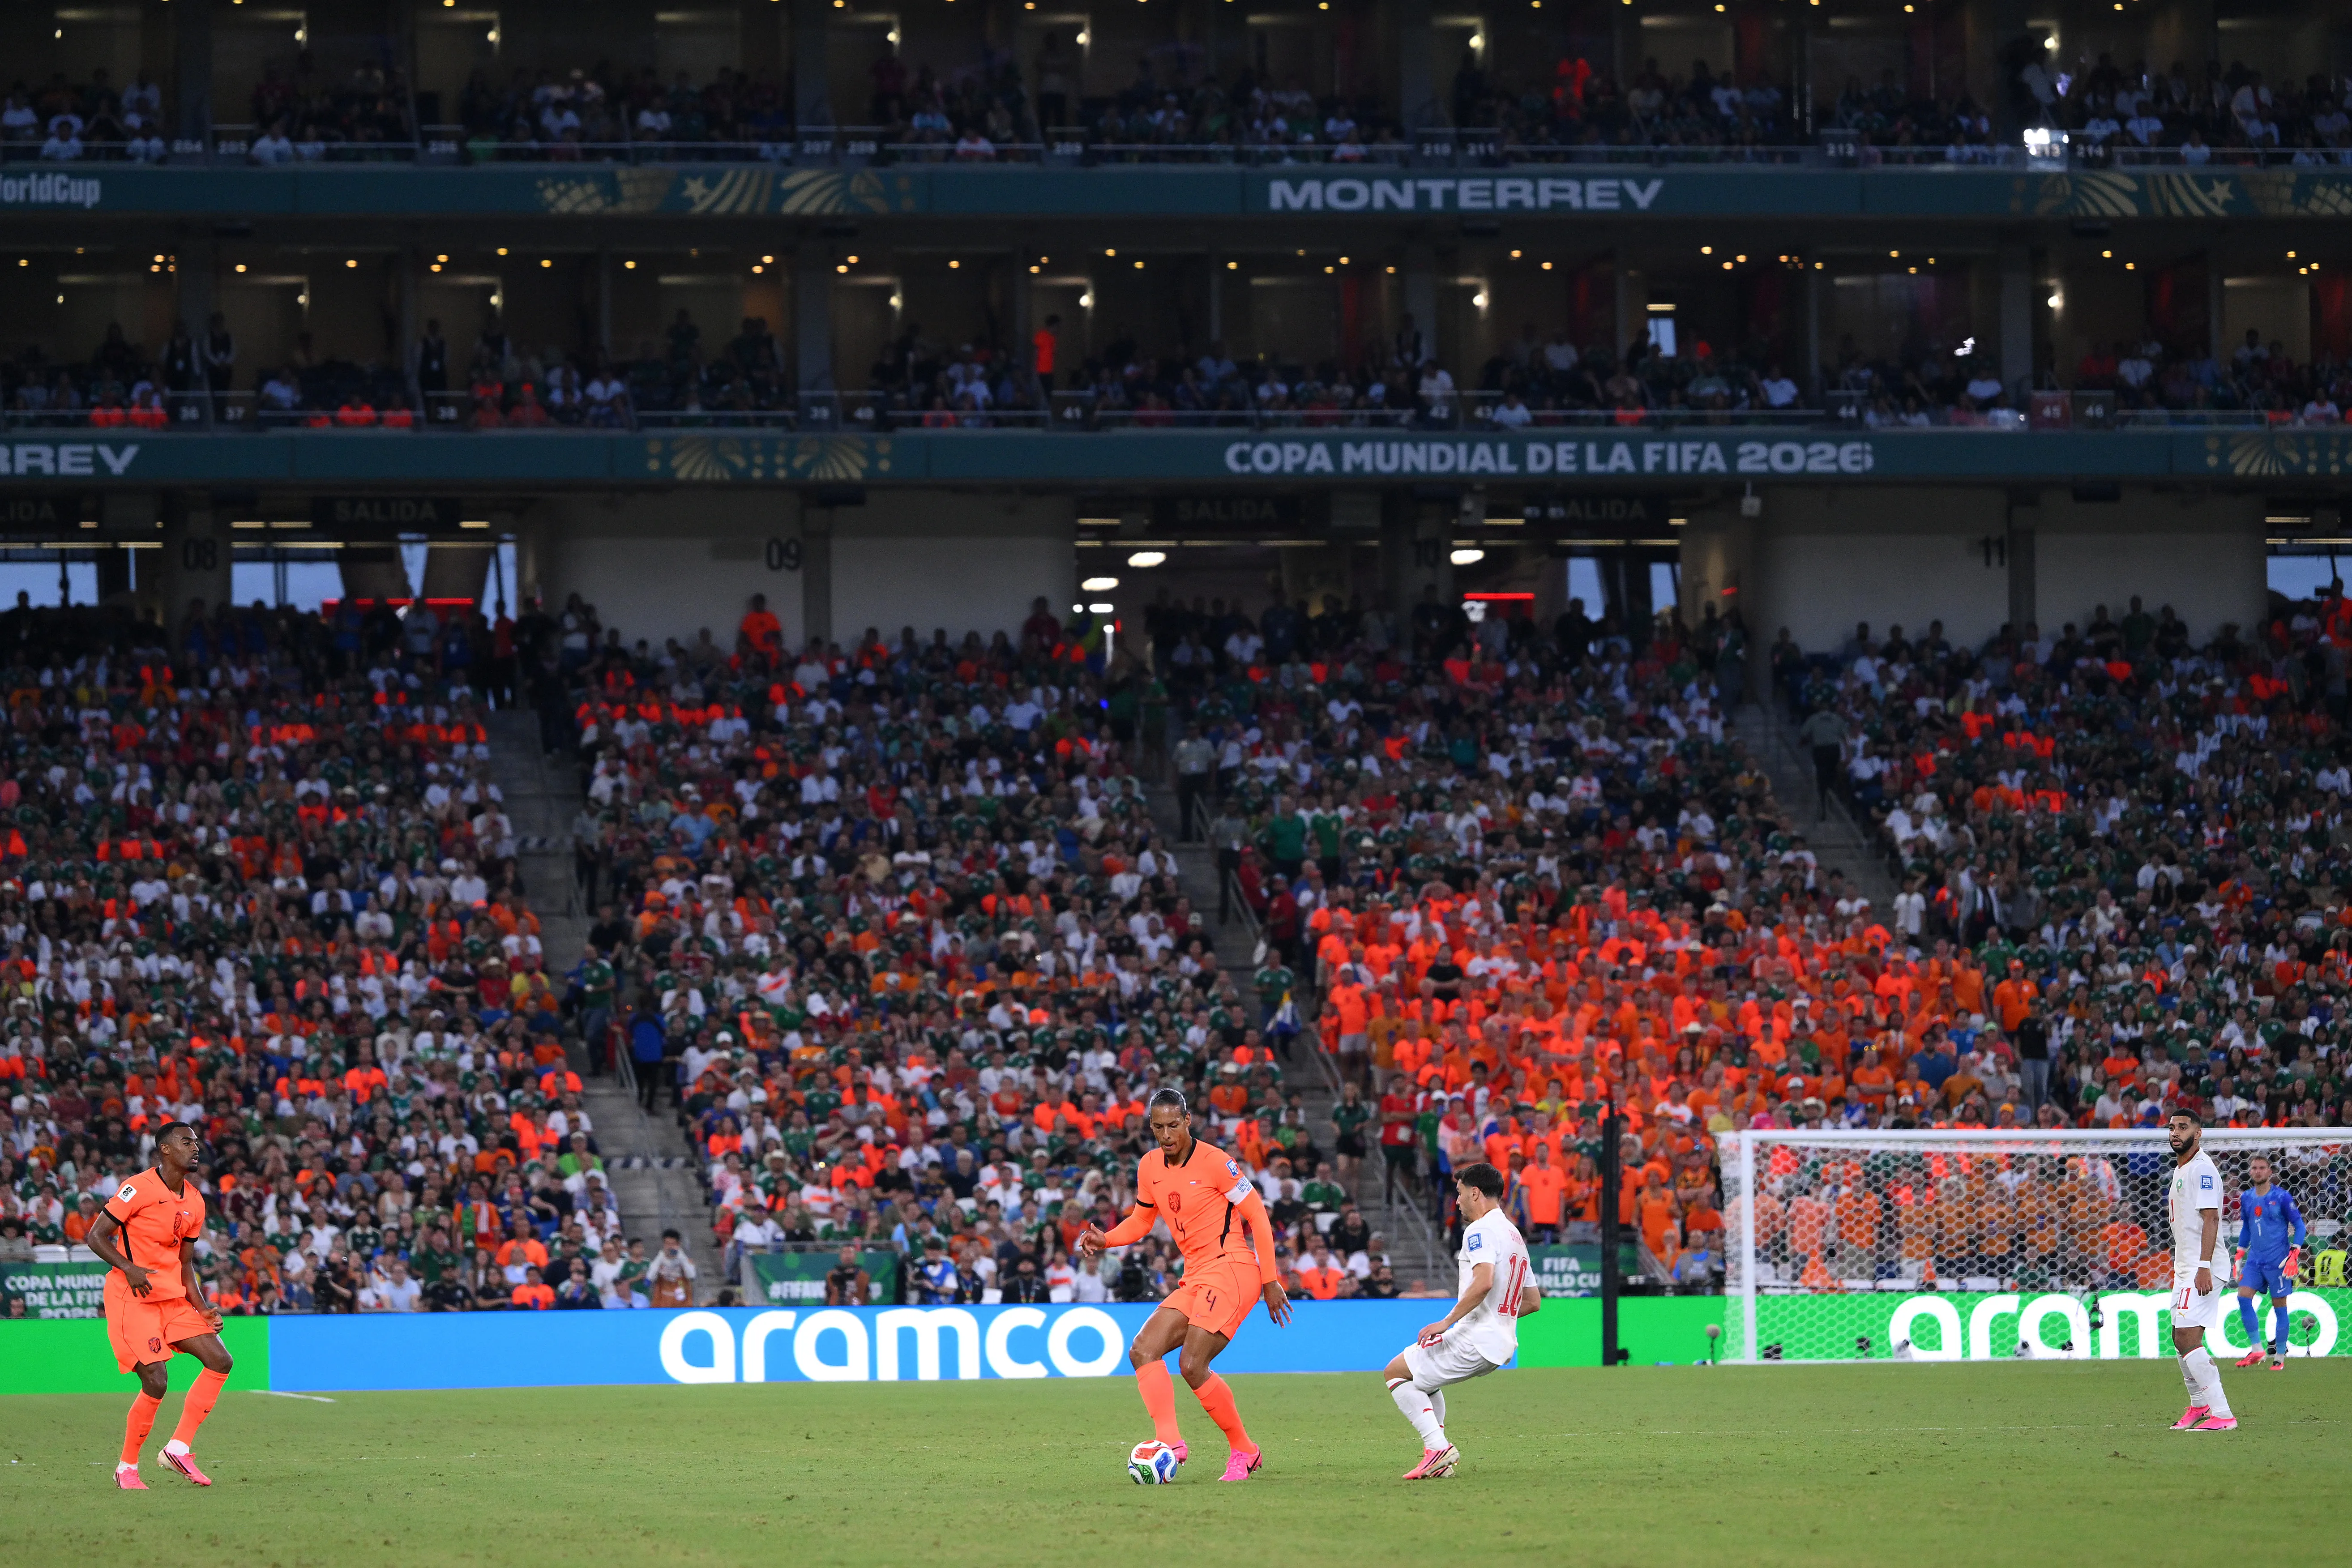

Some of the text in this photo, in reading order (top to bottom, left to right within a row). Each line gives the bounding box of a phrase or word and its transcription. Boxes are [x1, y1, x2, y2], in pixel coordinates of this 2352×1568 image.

[0, 172, 101, 209] orldCup
[1269, 179, 1664, 209] MONTERREY
[1063, 406, 1082, 419] 41
[1838, 405, 1858, 419] 44
[2042, 404, 2061, 418] 45
[2085, 404, 2105, 418] 46
[0, 444, 140, 474] REY
[1225, 443, 1874, 473] COPA MUNDIAL DE LA FIFA 2026
[336, 501, 437, 521] SALIDA
[1176, 499, 1278, 520] SALIDA
[1560, 498, 1646, 520] ALIDA
[183, 539, 217, 570] 08
[766, 538, 801, 570] 09
[1414, 539, 1439, 567] 10
[1979, 537, 2005, 568] 11
[1174, 1218, 1186, 1239] 4
[2257, 1223, 2262, 1237] 1
[1543, 1256, 1580, 1272] FIFA
[4, 1273, 106, 1291] COPA MUND
[1498, 1252, 1527, 1320] 10
[1535, 1273, 1601, 1288] ORLD CU
[2279, 1275, 2284, 1288] 1
[25, 1290, 104, 1307] DE LA FIF
[1206, 1289, 1217, 1312] 4
[2177, 1287, 2192, 1310] 11
[1889, 1292, 2338, 1360] aramco
[660, 1307, 1124, 1384] aramco
